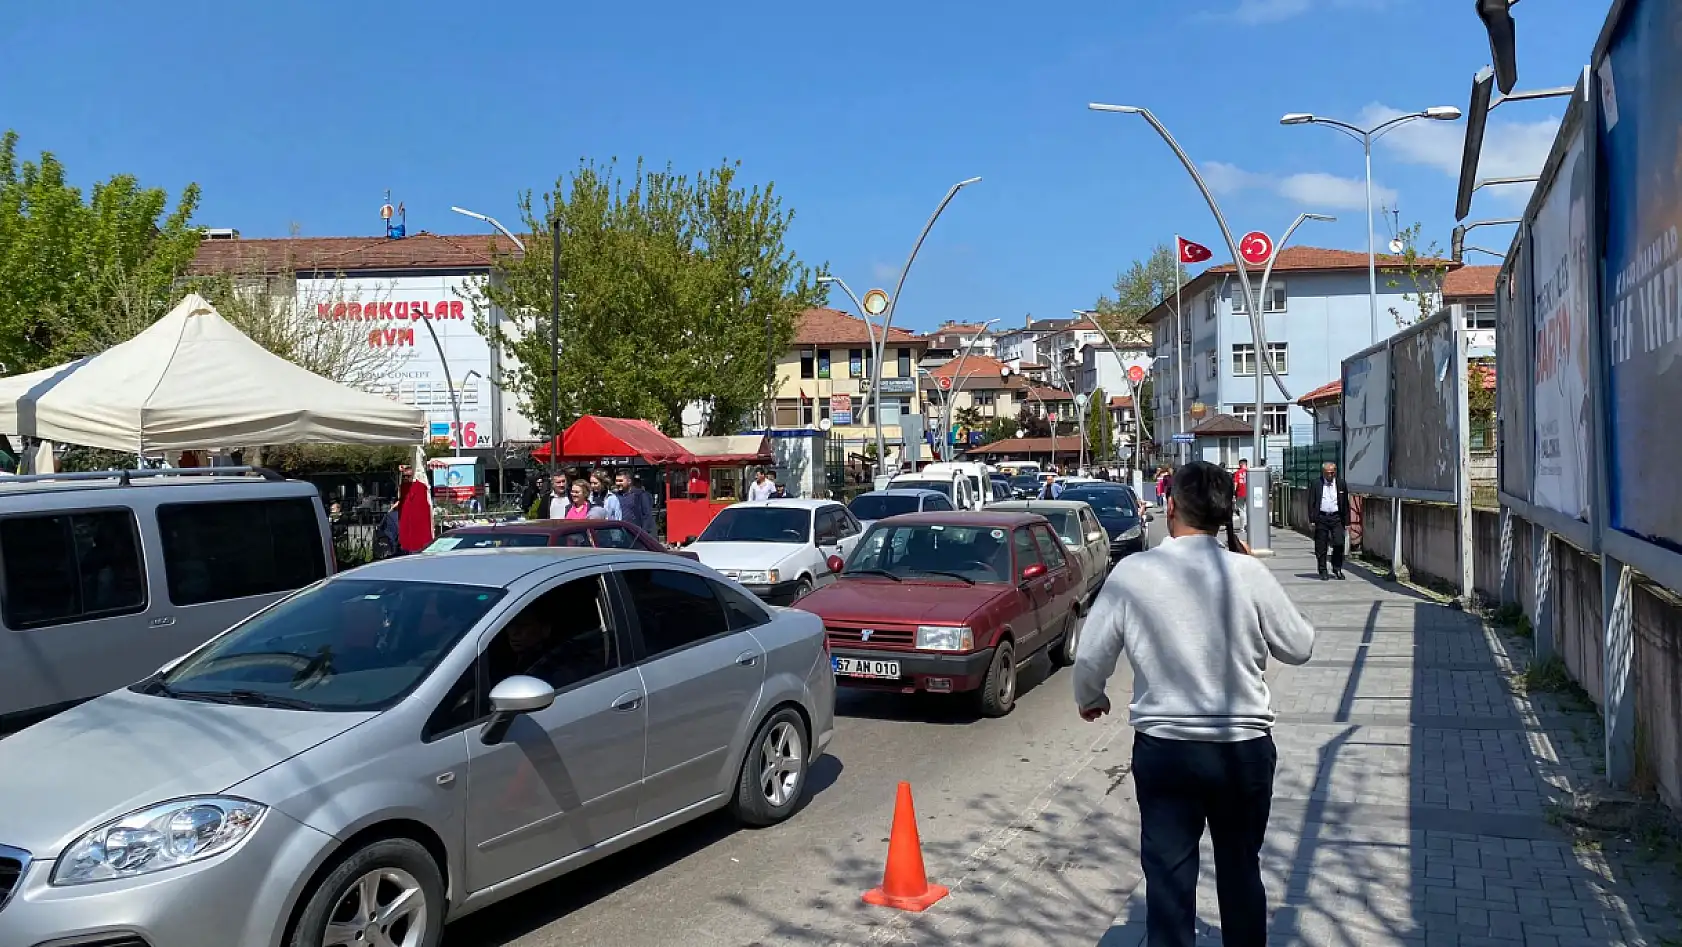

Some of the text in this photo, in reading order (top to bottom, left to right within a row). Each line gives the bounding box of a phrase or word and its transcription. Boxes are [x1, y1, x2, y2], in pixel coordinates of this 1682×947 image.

[368, 328, 414, 348] AVM
[478, 436, 490, 444] AY
[836, 660, 850, 671] 67
[875, 662, 897, 675] 010
